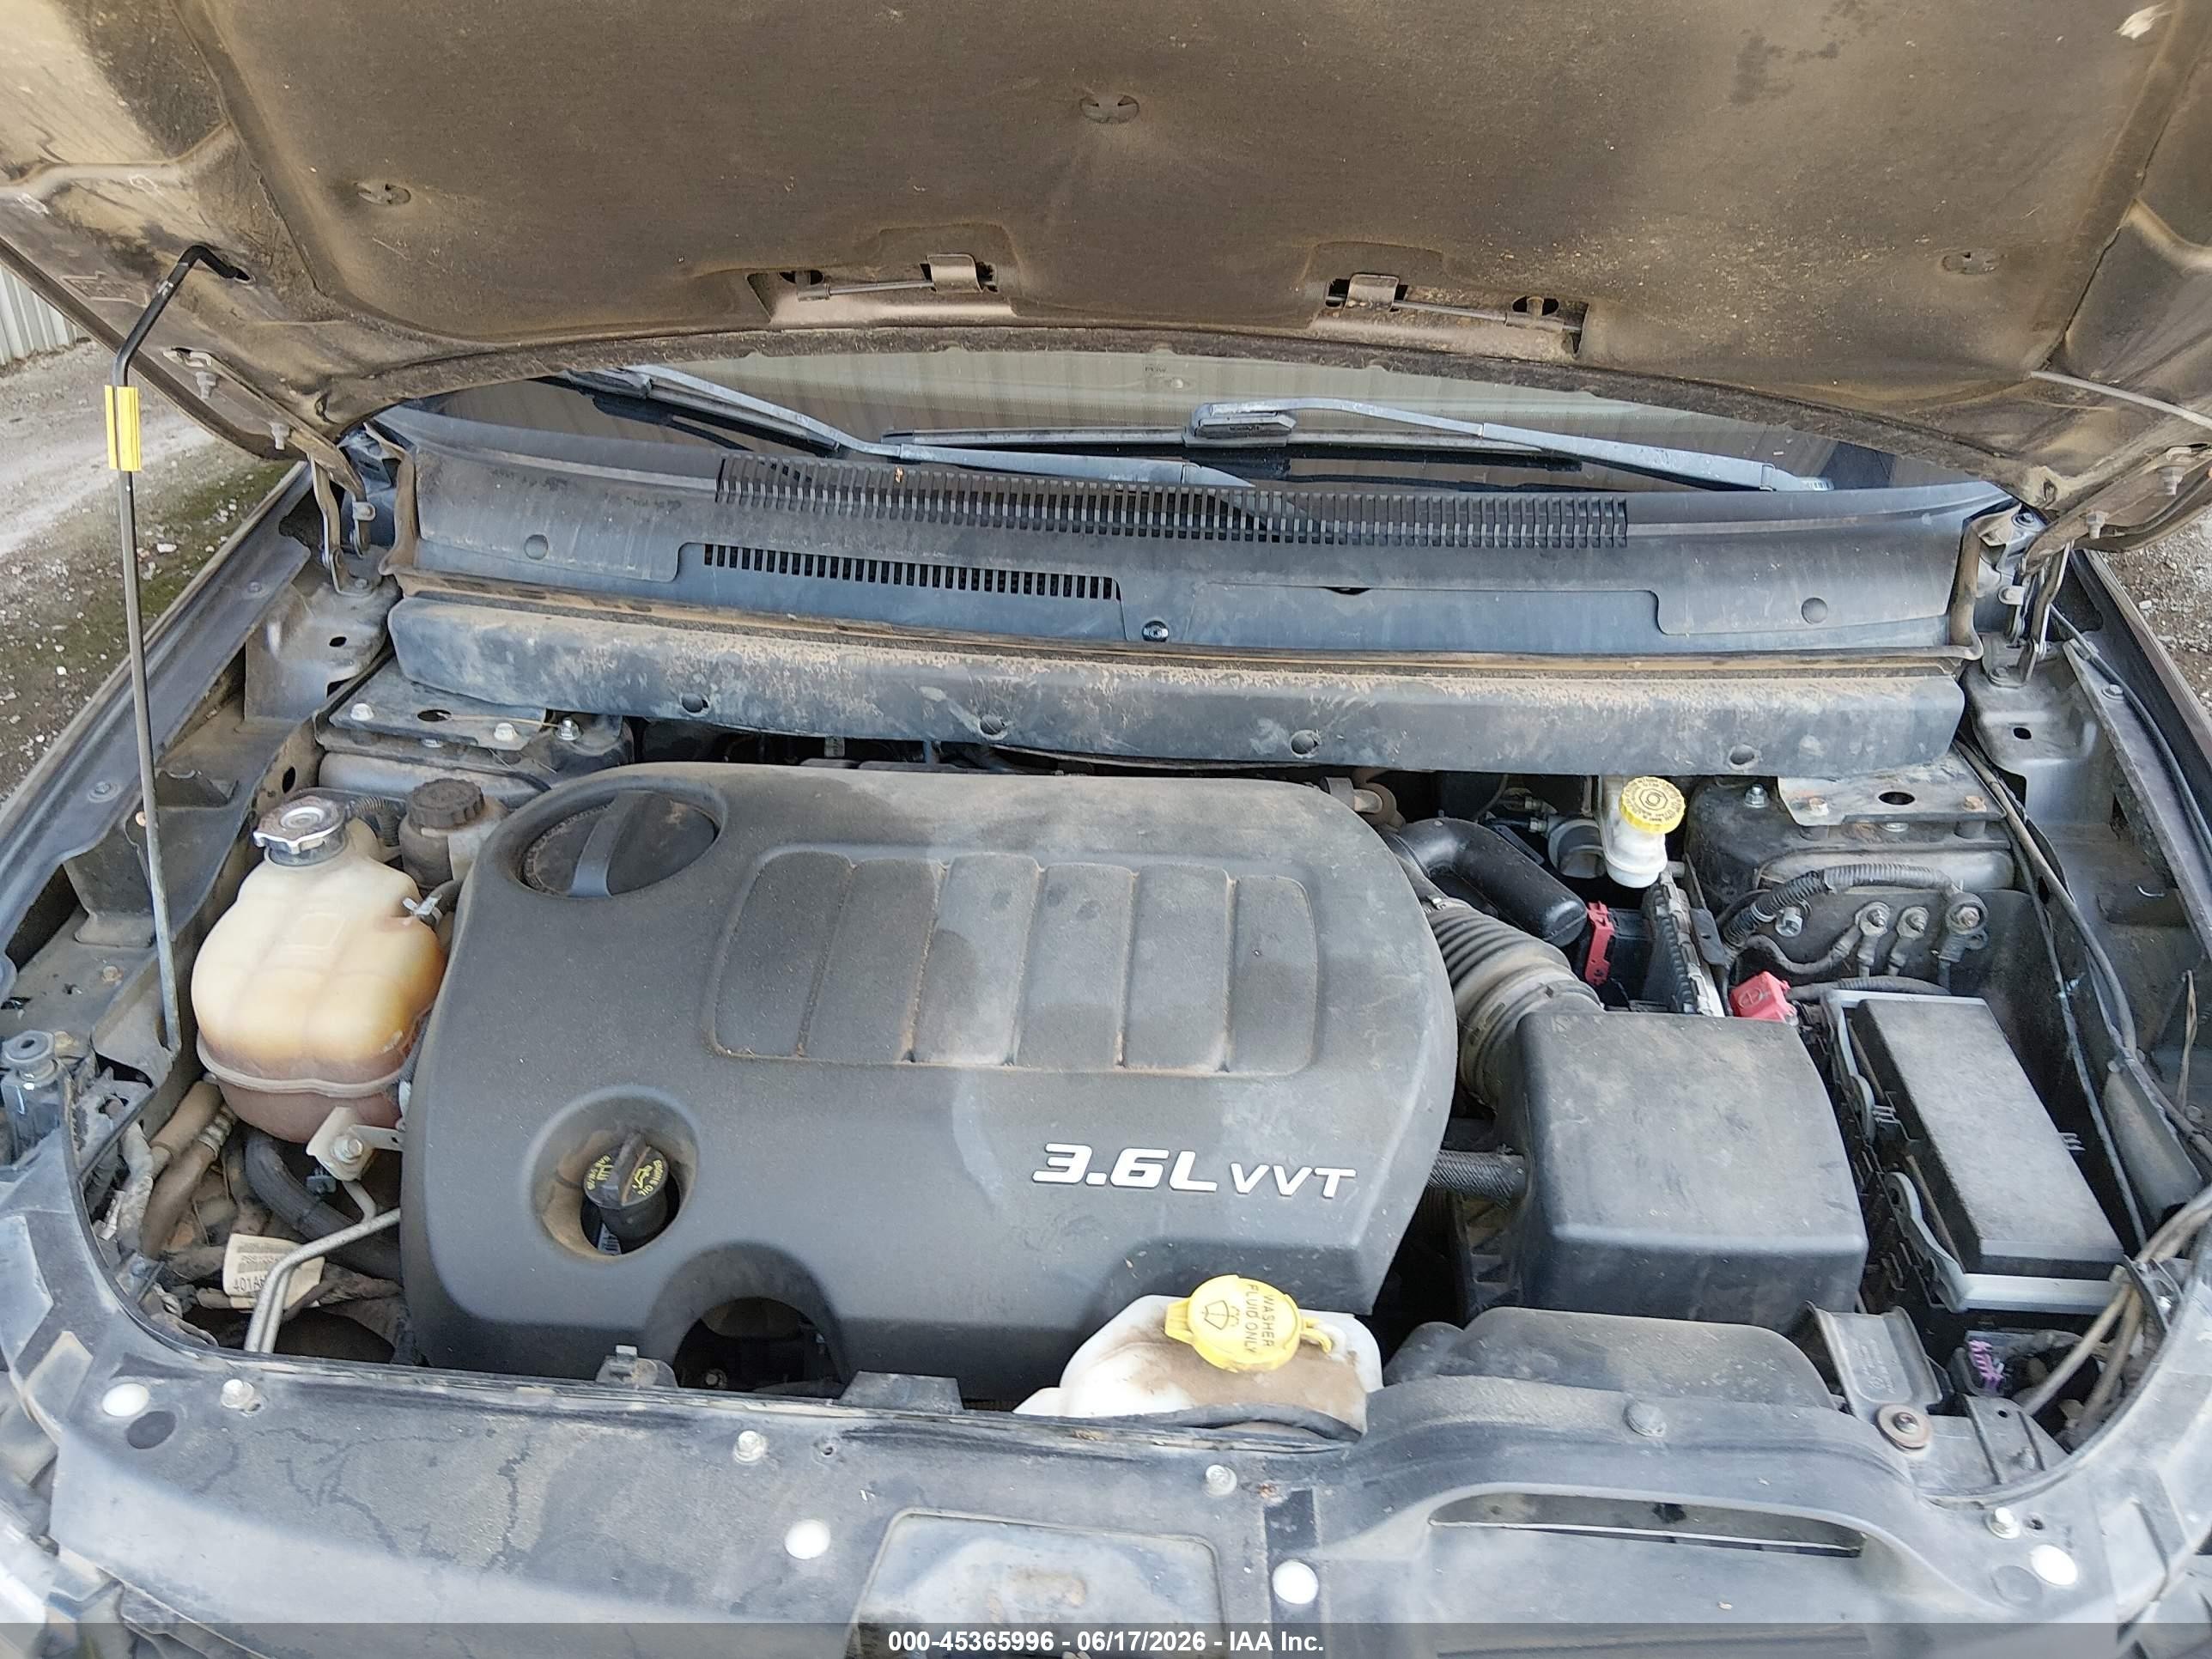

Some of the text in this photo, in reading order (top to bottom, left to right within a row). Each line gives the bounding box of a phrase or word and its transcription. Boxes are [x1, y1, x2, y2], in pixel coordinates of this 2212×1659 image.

[637, 1185, 654, 1196] OIL
[1032, 1143, 1357, 1199] 3.6L VVT
[1243, 1283, 1259, 1354] FLUID ONLY
[1261, 1294, 1275, 1348] WASHER
